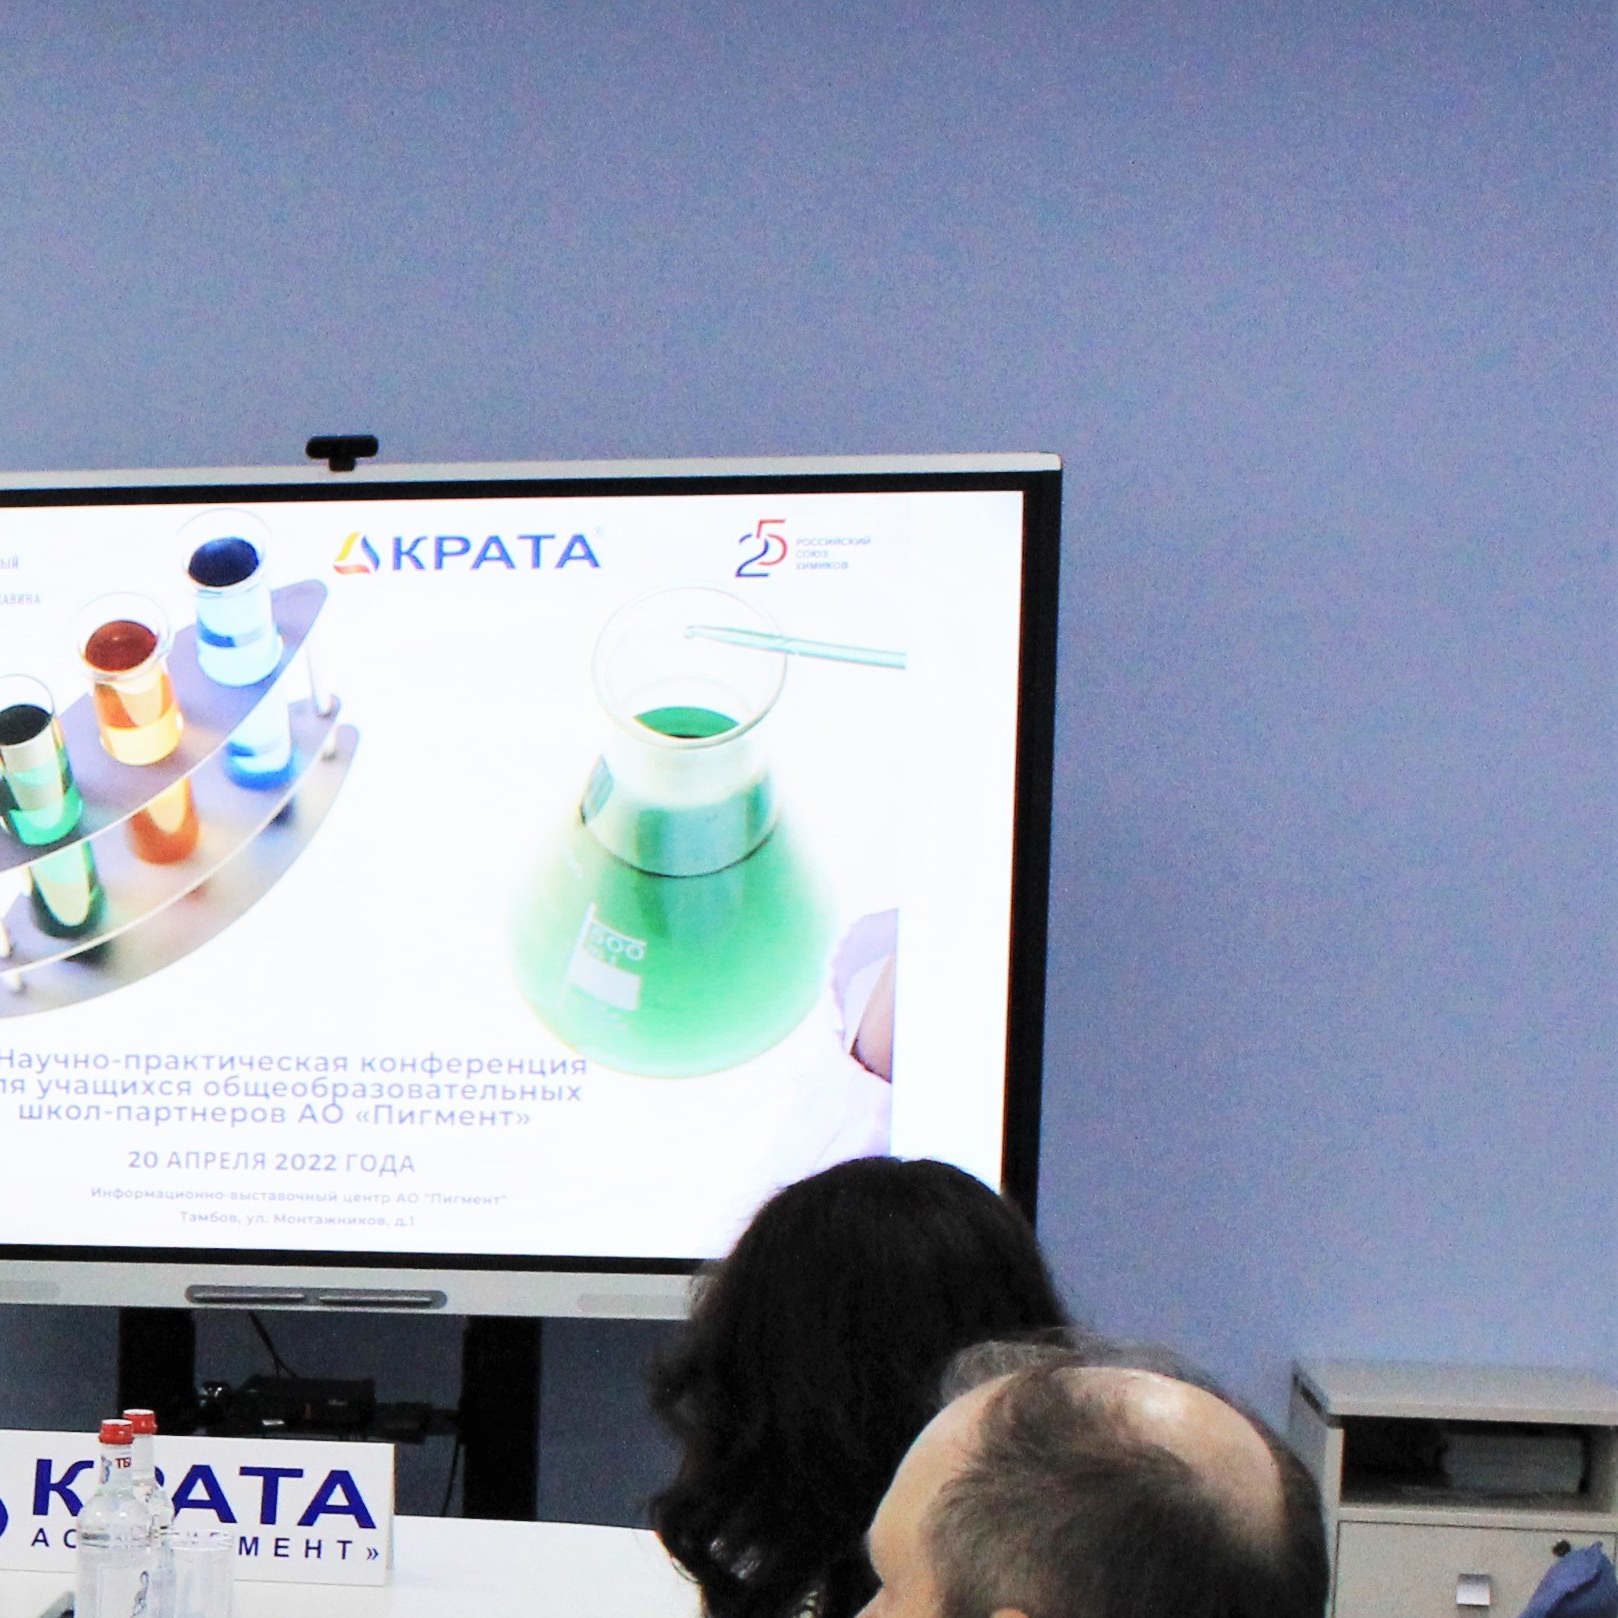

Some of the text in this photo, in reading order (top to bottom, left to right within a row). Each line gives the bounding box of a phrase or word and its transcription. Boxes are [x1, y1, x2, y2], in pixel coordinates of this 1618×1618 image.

[391, 533, 602, 571] КРАТА
[361, 1052, 587, 1079] конференция
[37, 1077, 193, 1100] учащихся
[203, 1075, 582, 1105] общеобразовательных
[18, 1102, 531, 1128] школ-партнеров АО «Пигмент»
[127, 1151, 415, 1177] 20 АПРЕЛЯ 2022 ГОДА
[90, 1187, 338, 1203] Информационно-выставочный
[343, 1193, 390, 1204] центр
[395, 1193, 419, 1203] АО
[180, 1211, 242, 1225] Тамбов,
[246, 1214, 270, 1226] ул.
[273, 1213, 390, 1226] Монтажников,
[32, 1458, 377, 1530] КАТА
